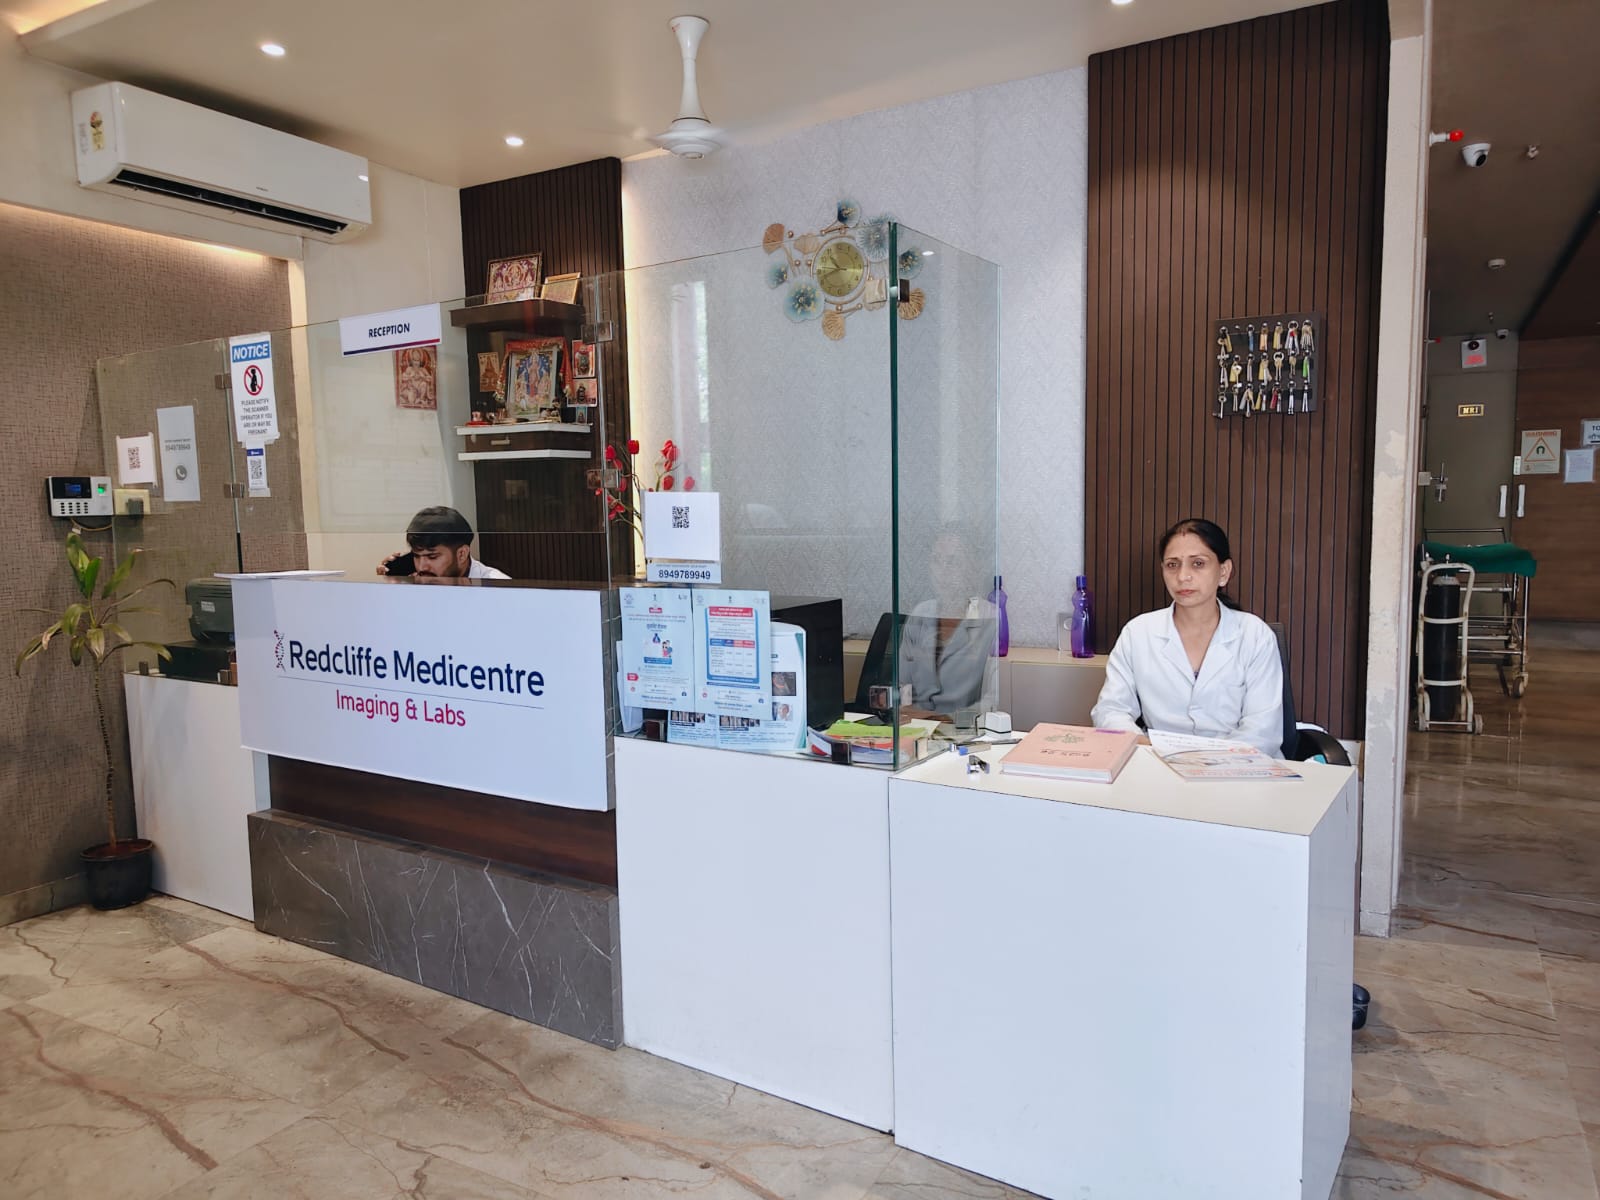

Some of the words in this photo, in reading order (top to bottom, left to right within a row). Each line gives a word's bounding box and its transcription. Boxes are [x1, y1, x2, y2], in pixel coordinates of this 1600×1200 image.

[368, 323, 411, 338] RECEPTION
[233, 343, 269, 361] NOTICE
[1463, 406, 1478, 414] MRI
[658, 569, 711, 580] 8949789949
[289, 640, 387, 679] Redcliffe
[393, 650, 545, 697] Medicentre
[336, 689, 399, 722] Imaging
[405, 698, 418, 720] &
[424, 700, 466, 726] Labs
